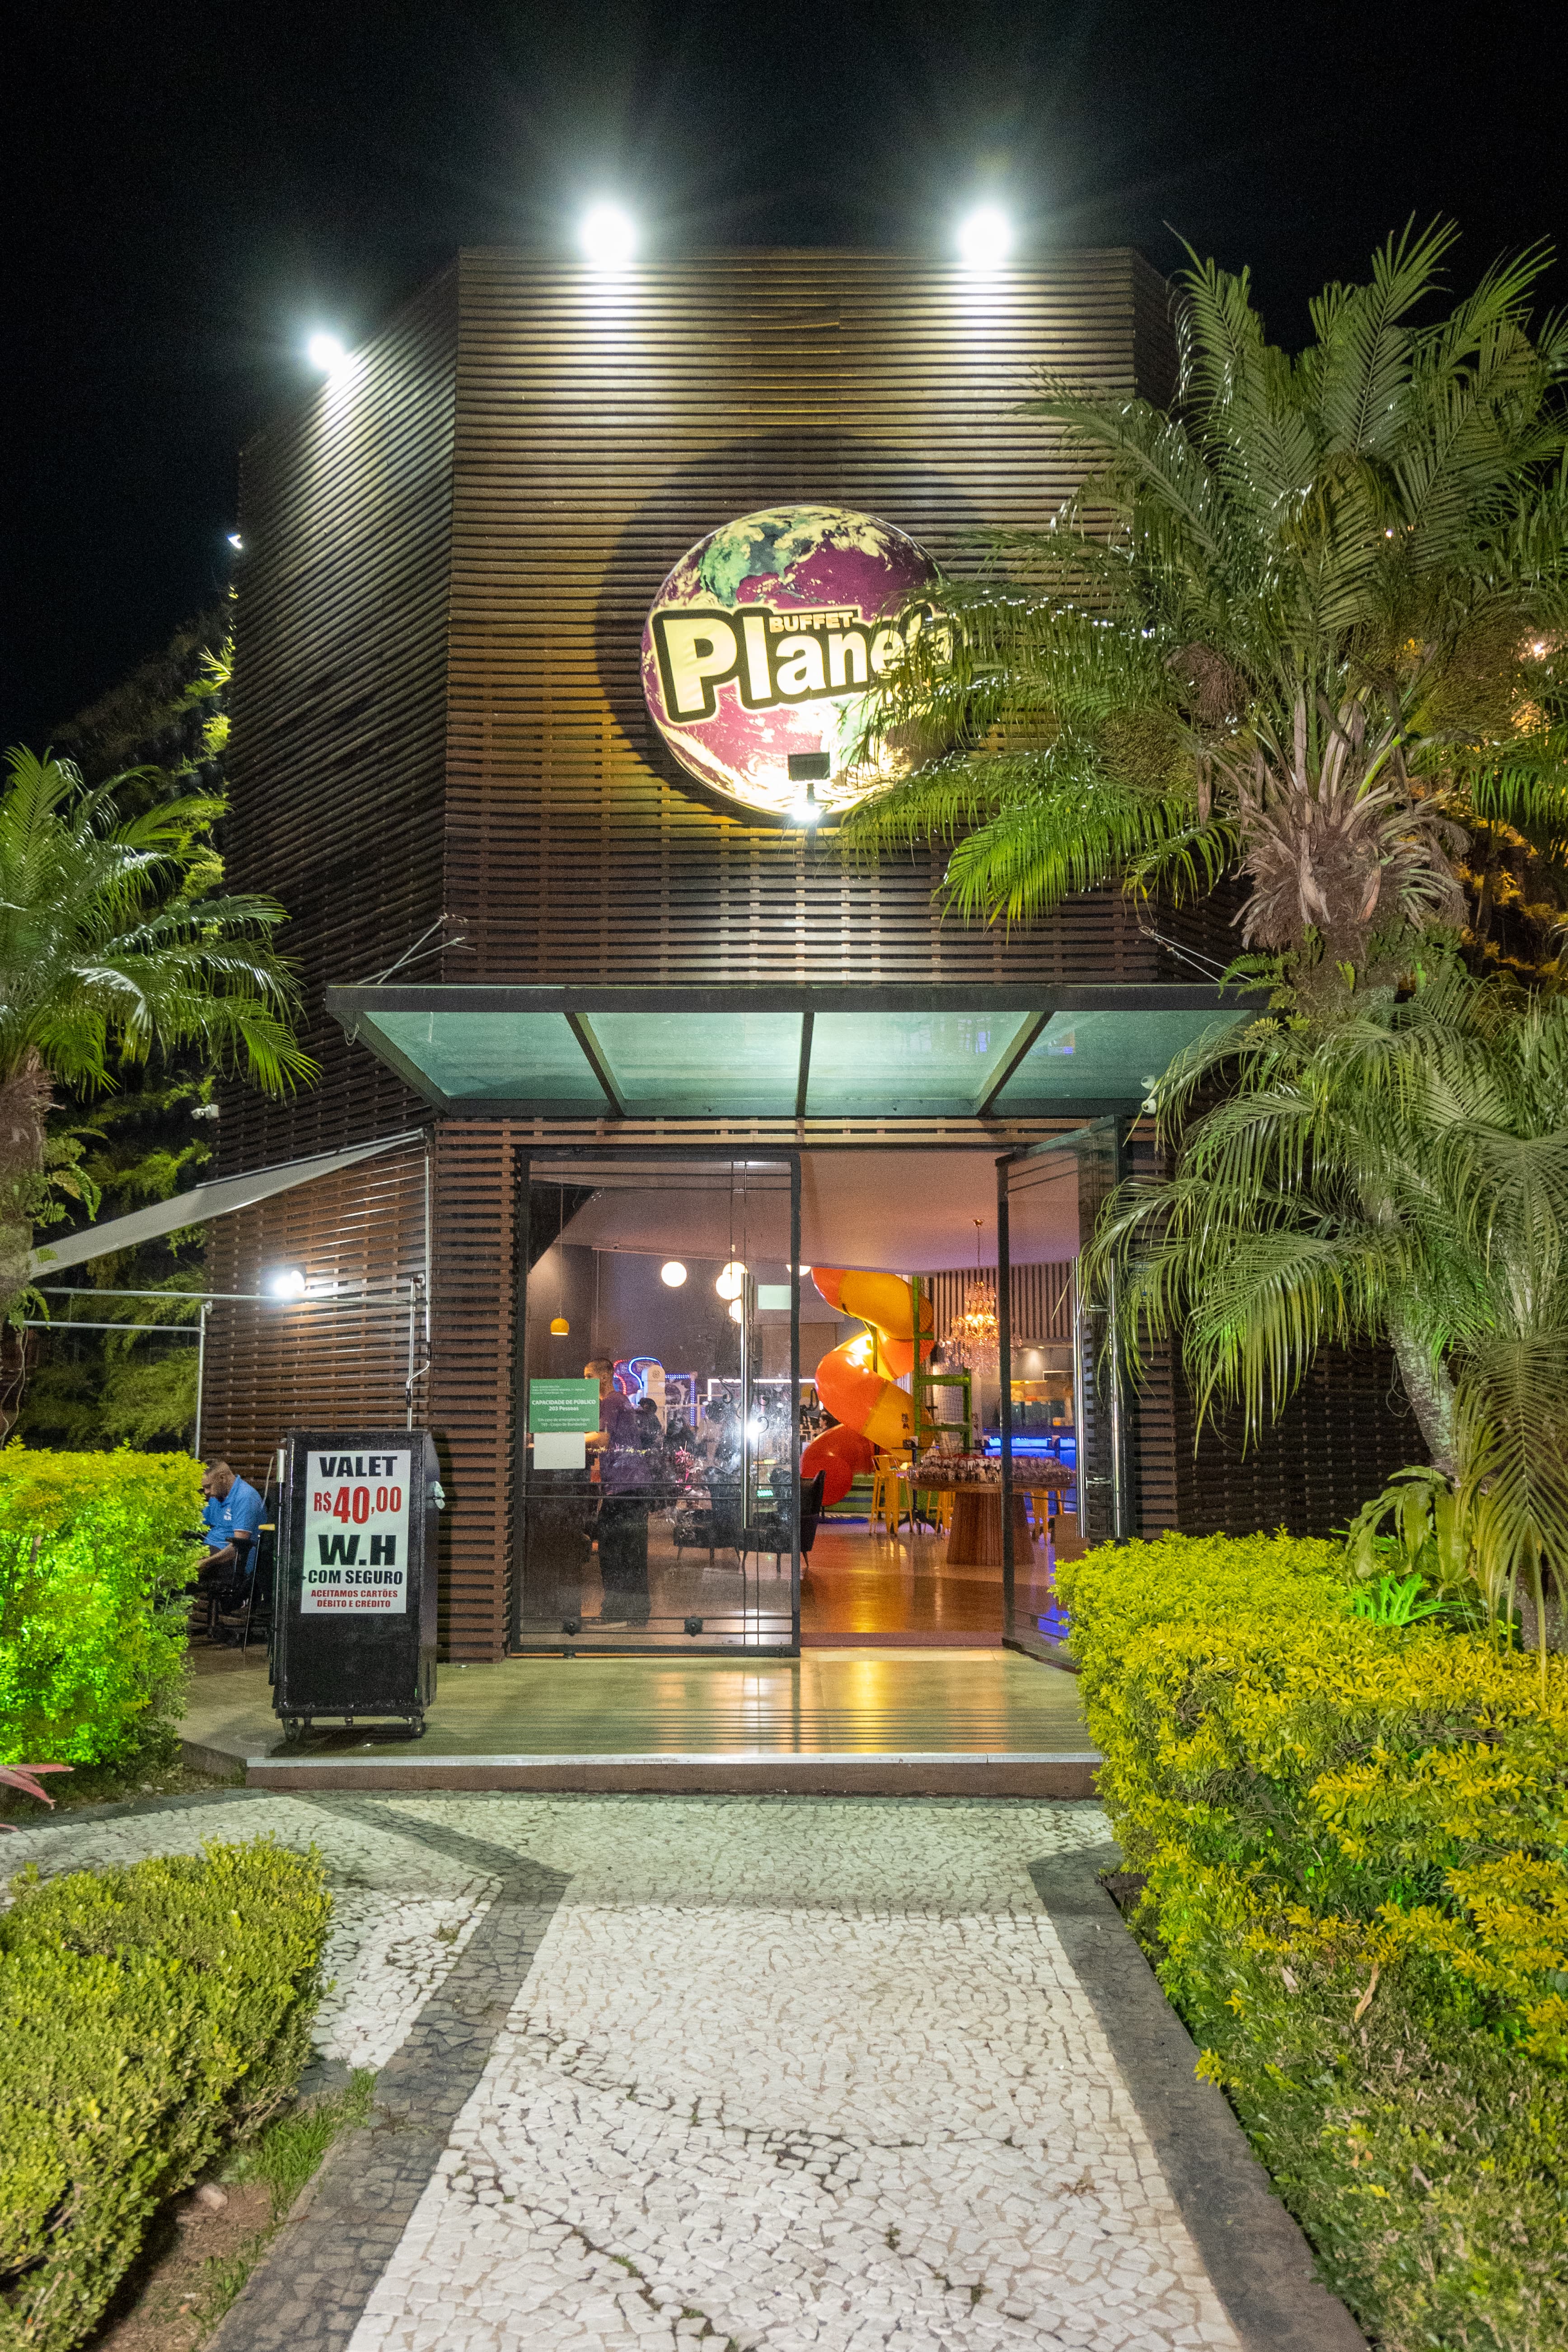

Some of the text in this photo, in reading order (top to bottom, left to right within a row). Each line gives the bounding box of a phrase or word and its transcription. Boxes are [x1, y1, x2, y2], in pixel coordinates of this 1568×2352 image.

[769, 611, 853, 633] BUFFET
[319, 1456, 398, 1477] VALET
[318, 1535, 397, 1565] W.H
[308, 1570, 403, 1585] COM SEGURO
[317, 1598, 346, 1607] DÉBITO
[360, 1589, 398, 1598] CARTÕES
